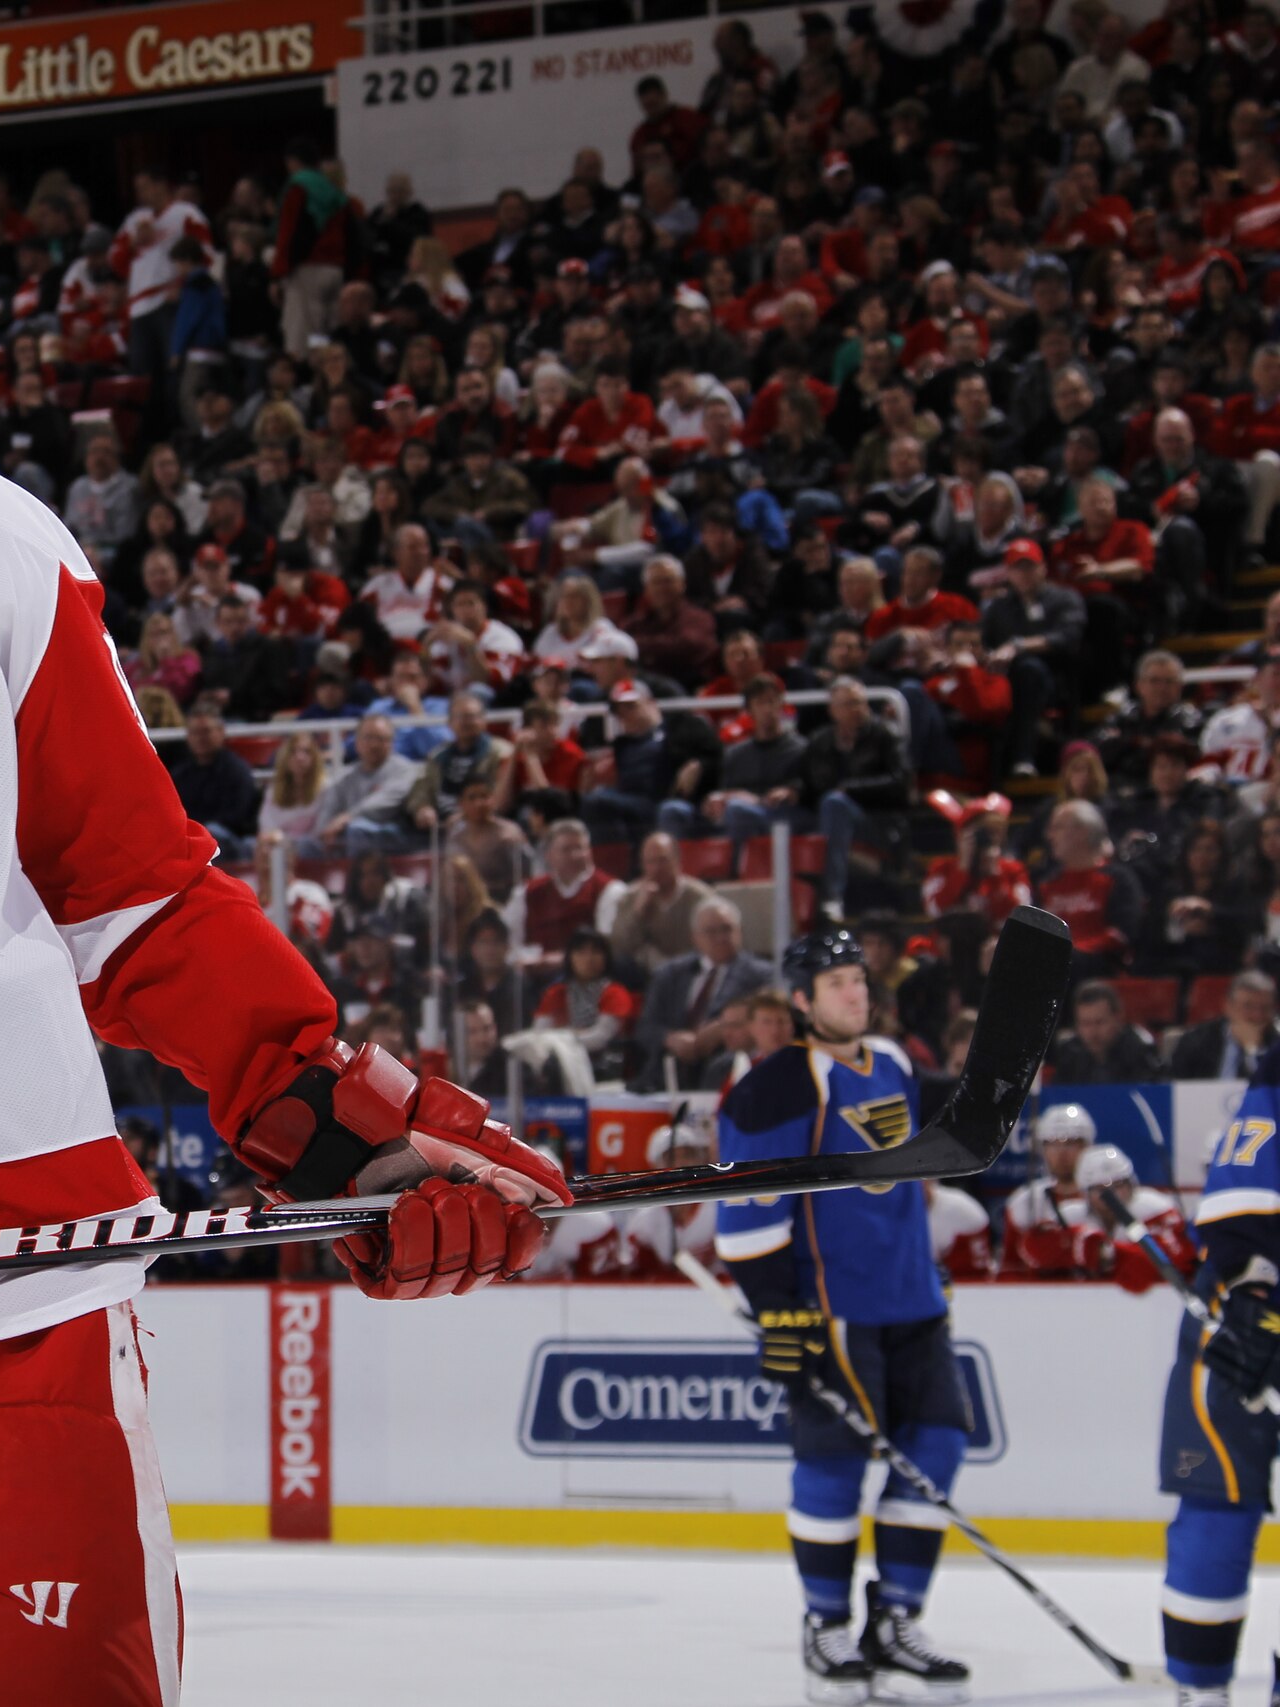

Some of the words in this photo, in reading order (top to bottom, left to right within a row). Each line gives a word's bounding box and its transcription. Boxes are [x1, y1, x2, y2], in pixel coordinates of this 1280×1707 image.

[126, 24, 314, 90] Caesars
[363, 67, 438, 105] 220
[450, 58, 513, 97] 221
[573, 40, 694, 79] STANDING
[1217, 1117, 1275, 1166] 17
[279, 1292, 320, 1498] Reebok
